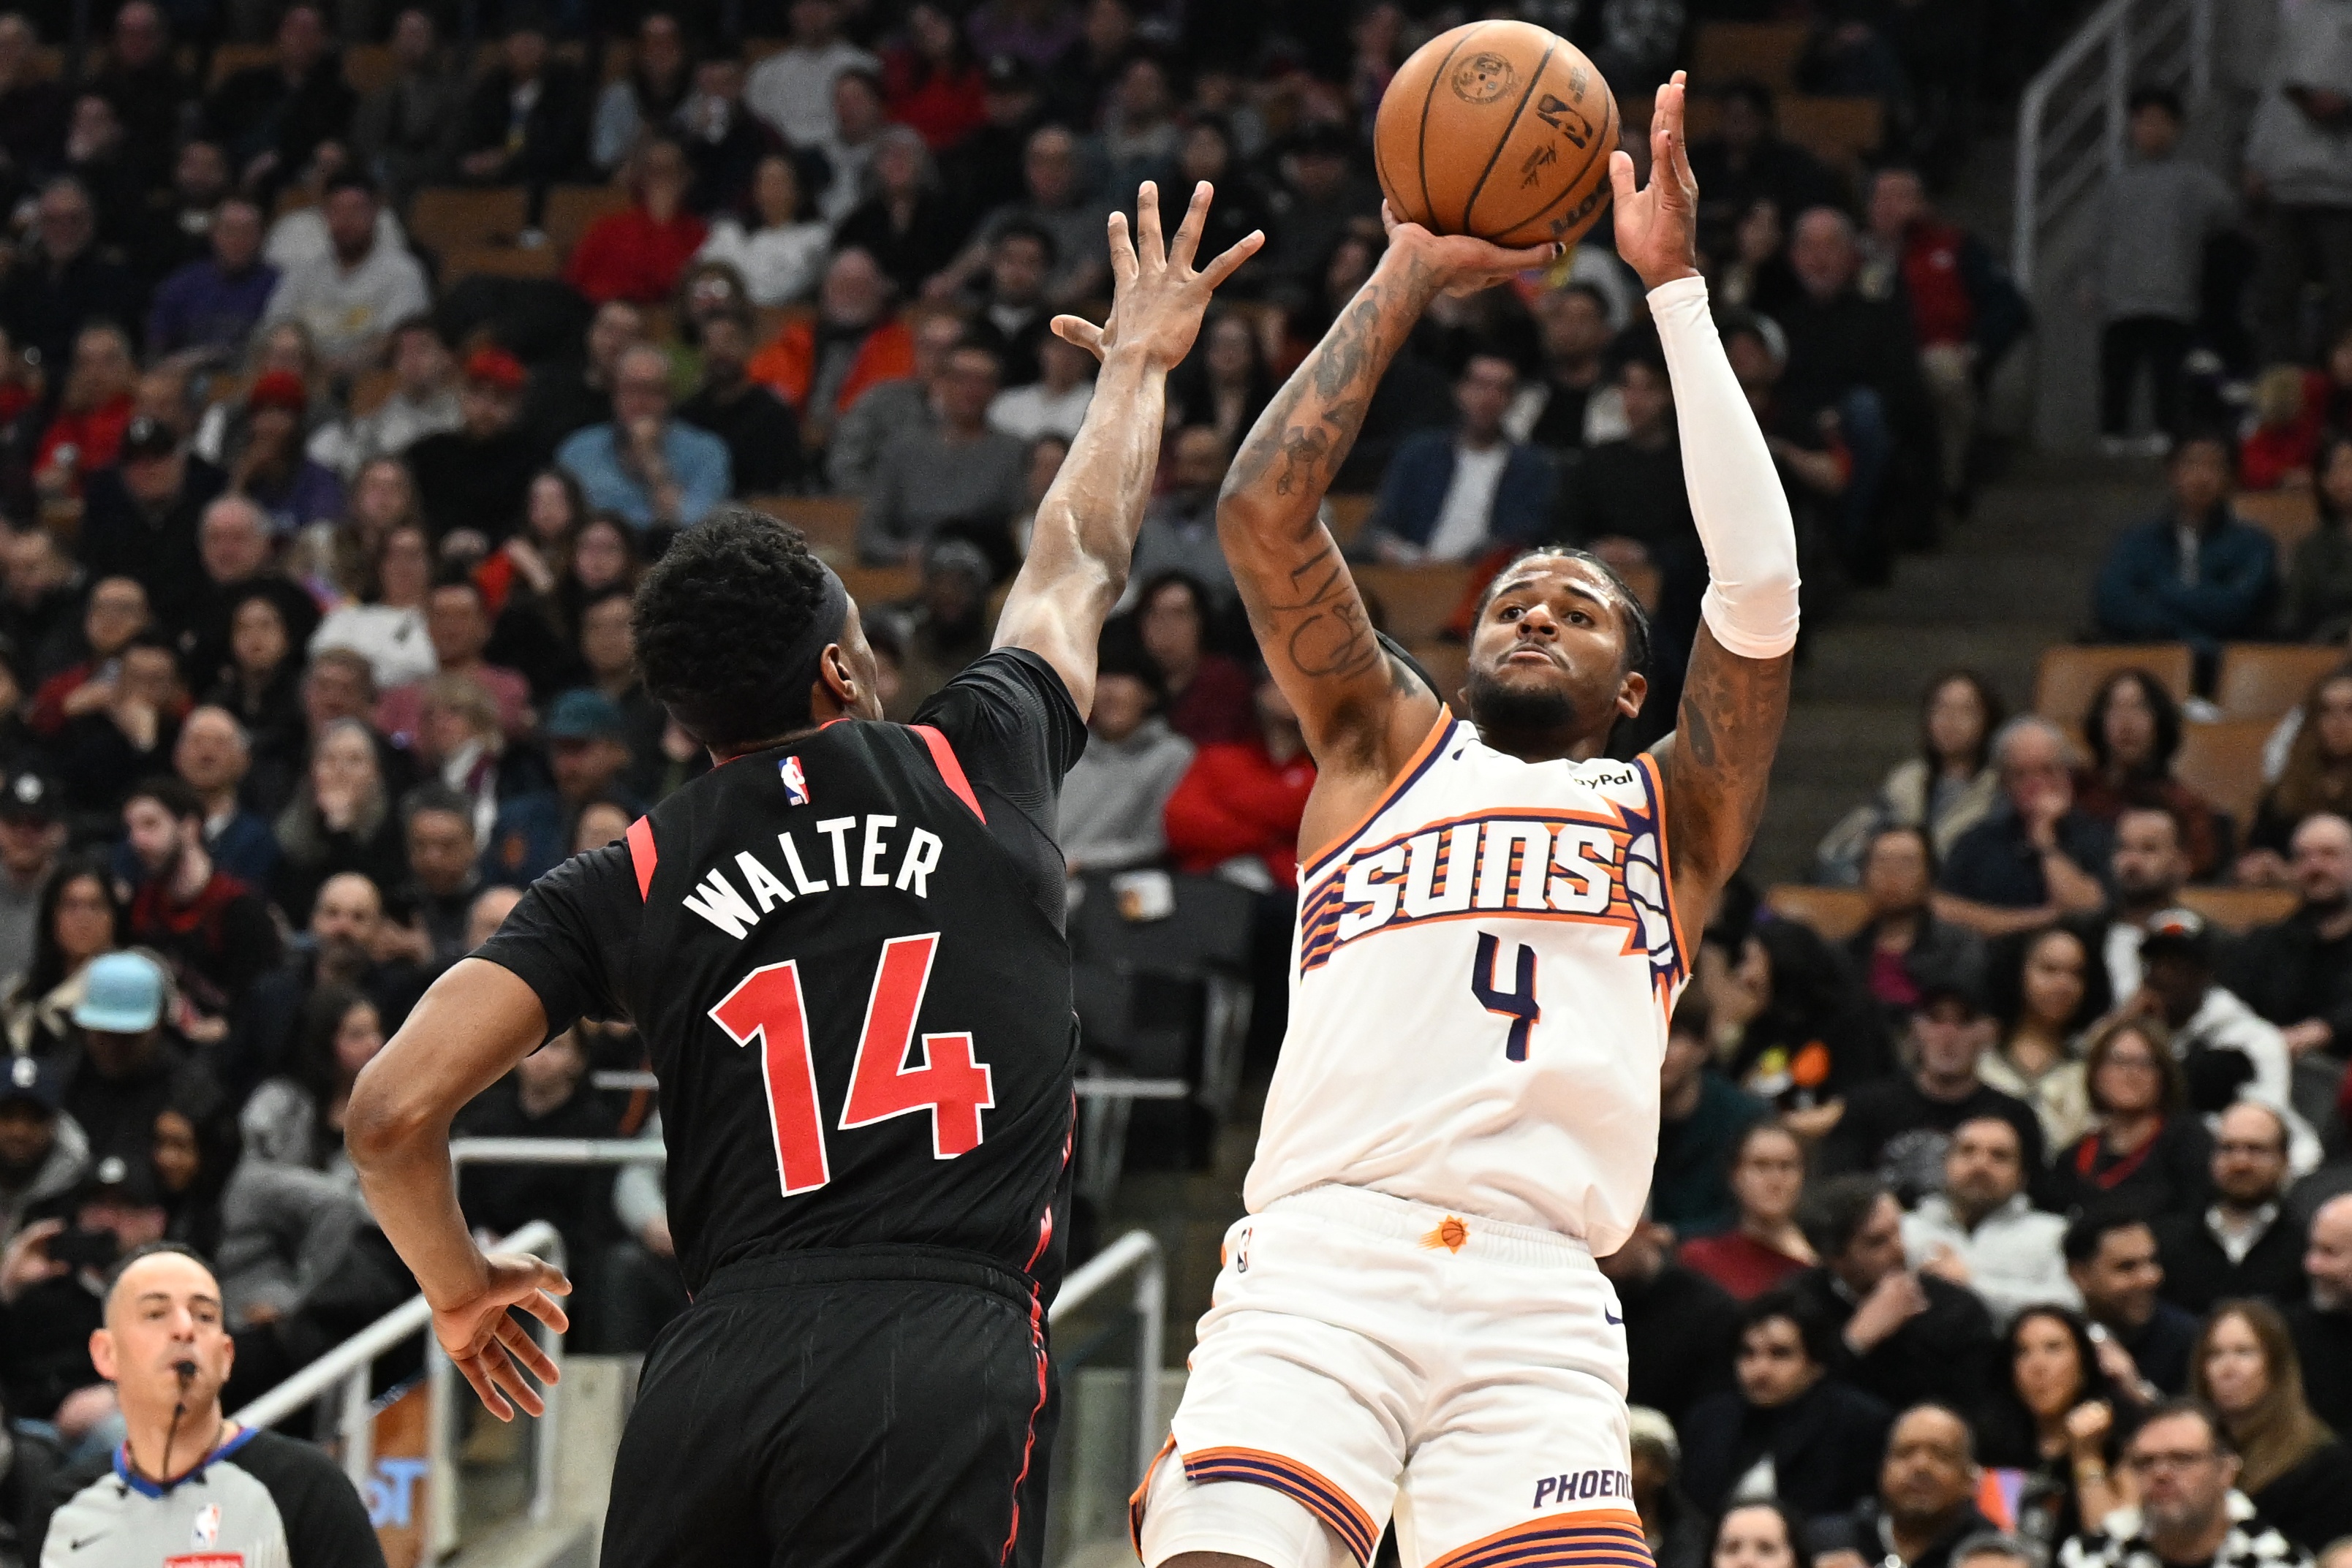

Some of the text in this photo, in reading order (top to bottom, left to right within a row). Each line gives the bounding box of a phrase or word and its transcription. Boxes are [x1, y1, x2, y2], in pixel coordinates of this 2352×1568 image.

[1570, 769, 1633, 789] ayPal
[682, 814, 943, 941] WALTER
[1336, 820, 1616, 942] SUNS
[1471, 929, 1540, 1063] 4
[707, 932, 995, 1197] 14
